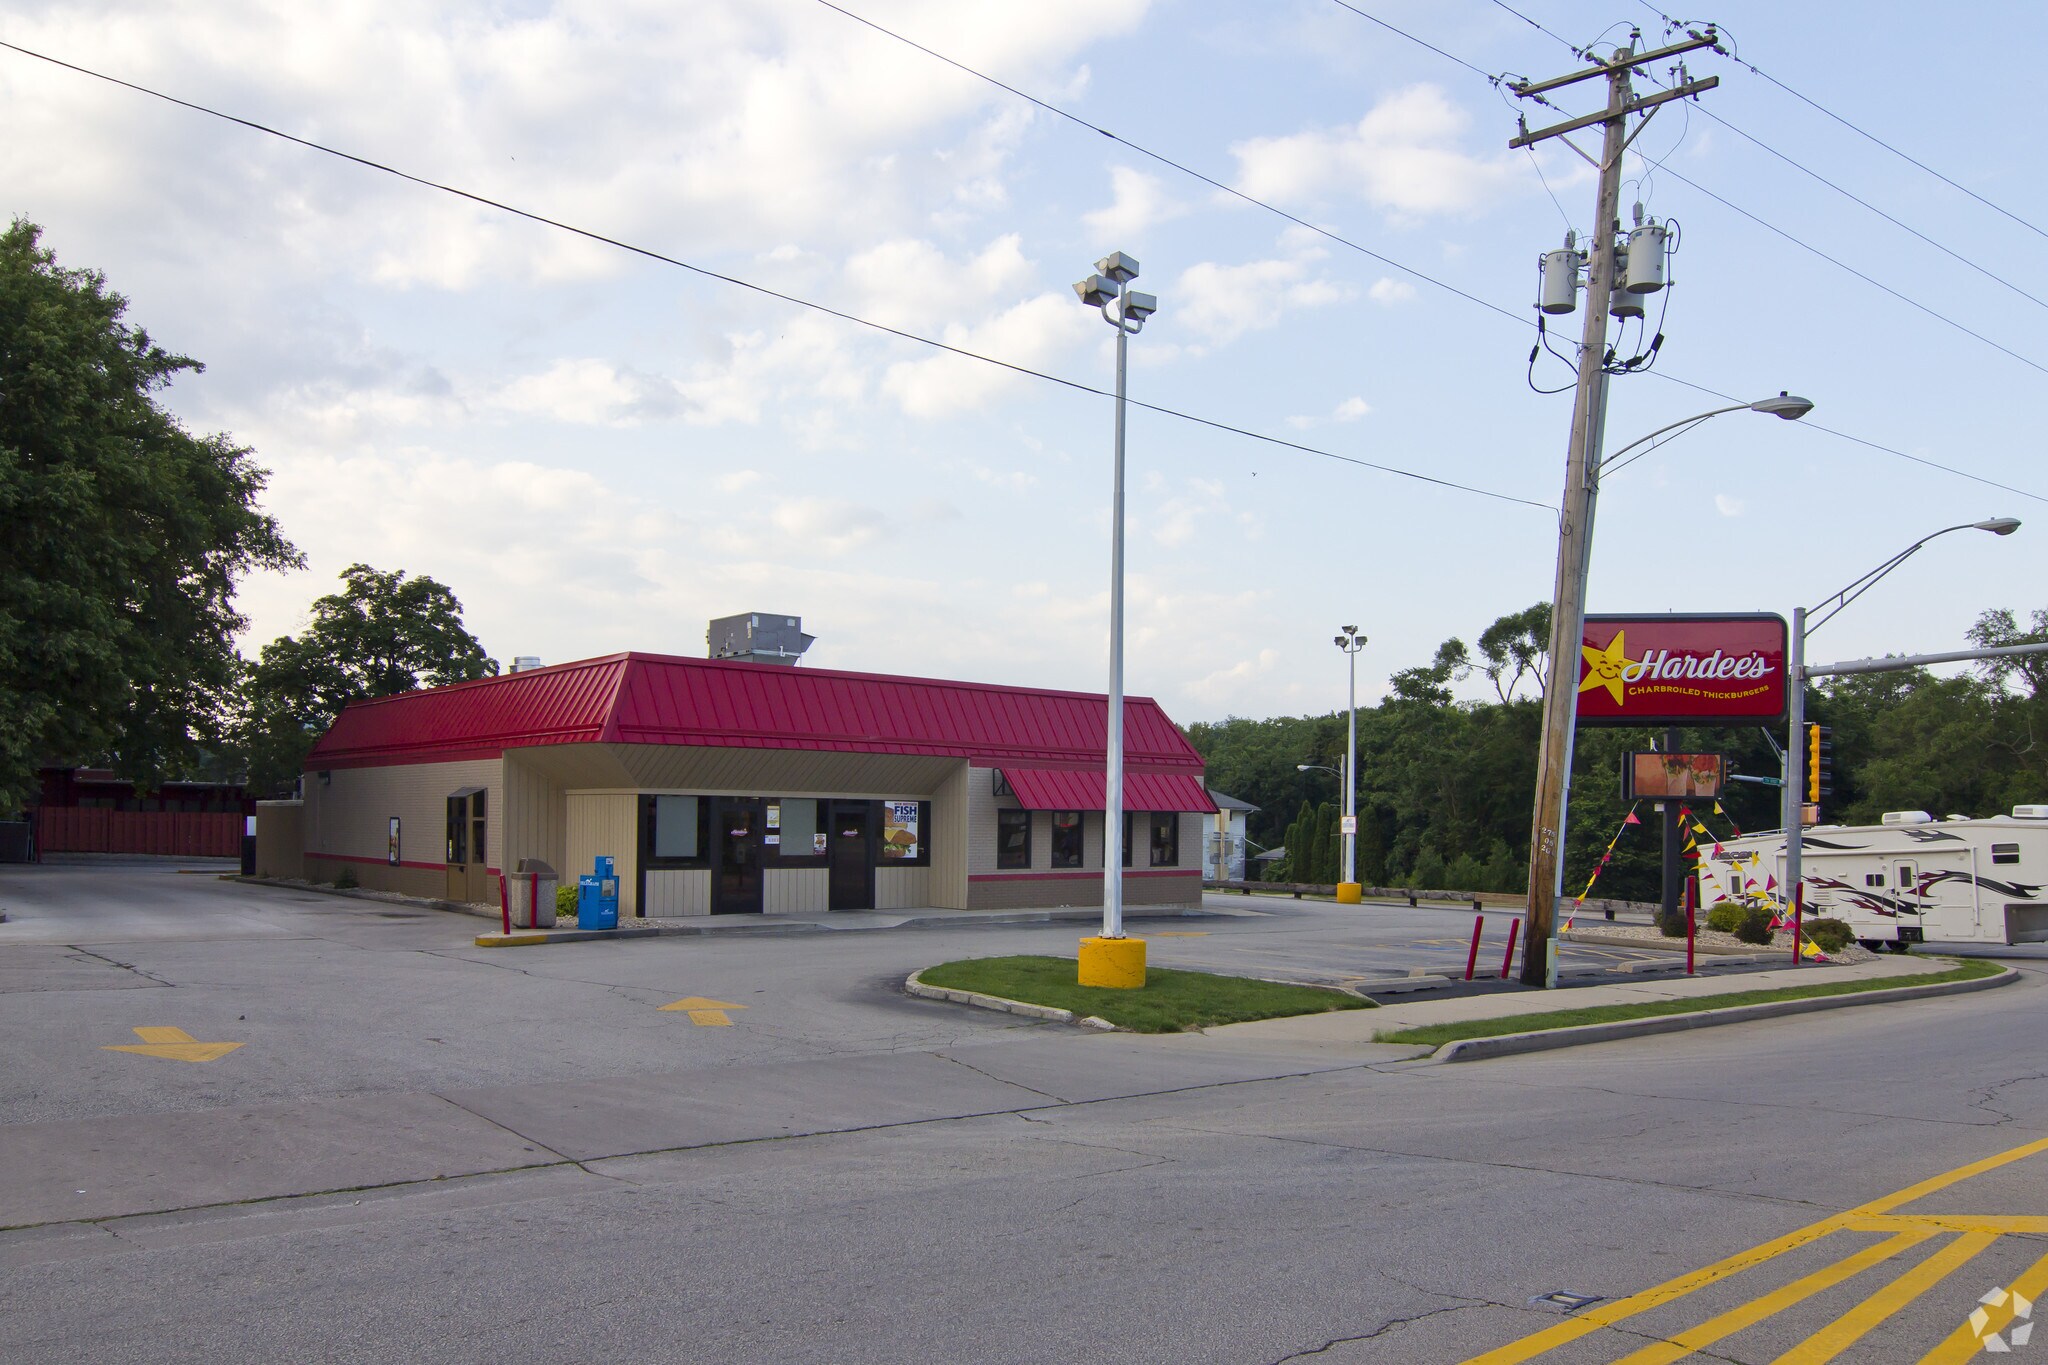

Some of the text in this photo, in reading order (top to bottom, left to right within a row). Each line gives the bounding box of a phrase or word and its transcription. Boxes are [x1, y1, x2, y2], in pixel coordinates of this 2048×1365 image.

[1621, 649, 1775, 682] Hardee's
[1628, 684, 1770, 699] CHARBROILED THICKBURGERS
[894, 805, 917, 815] FISH
[894, 815, 917, 823] SUPREME
